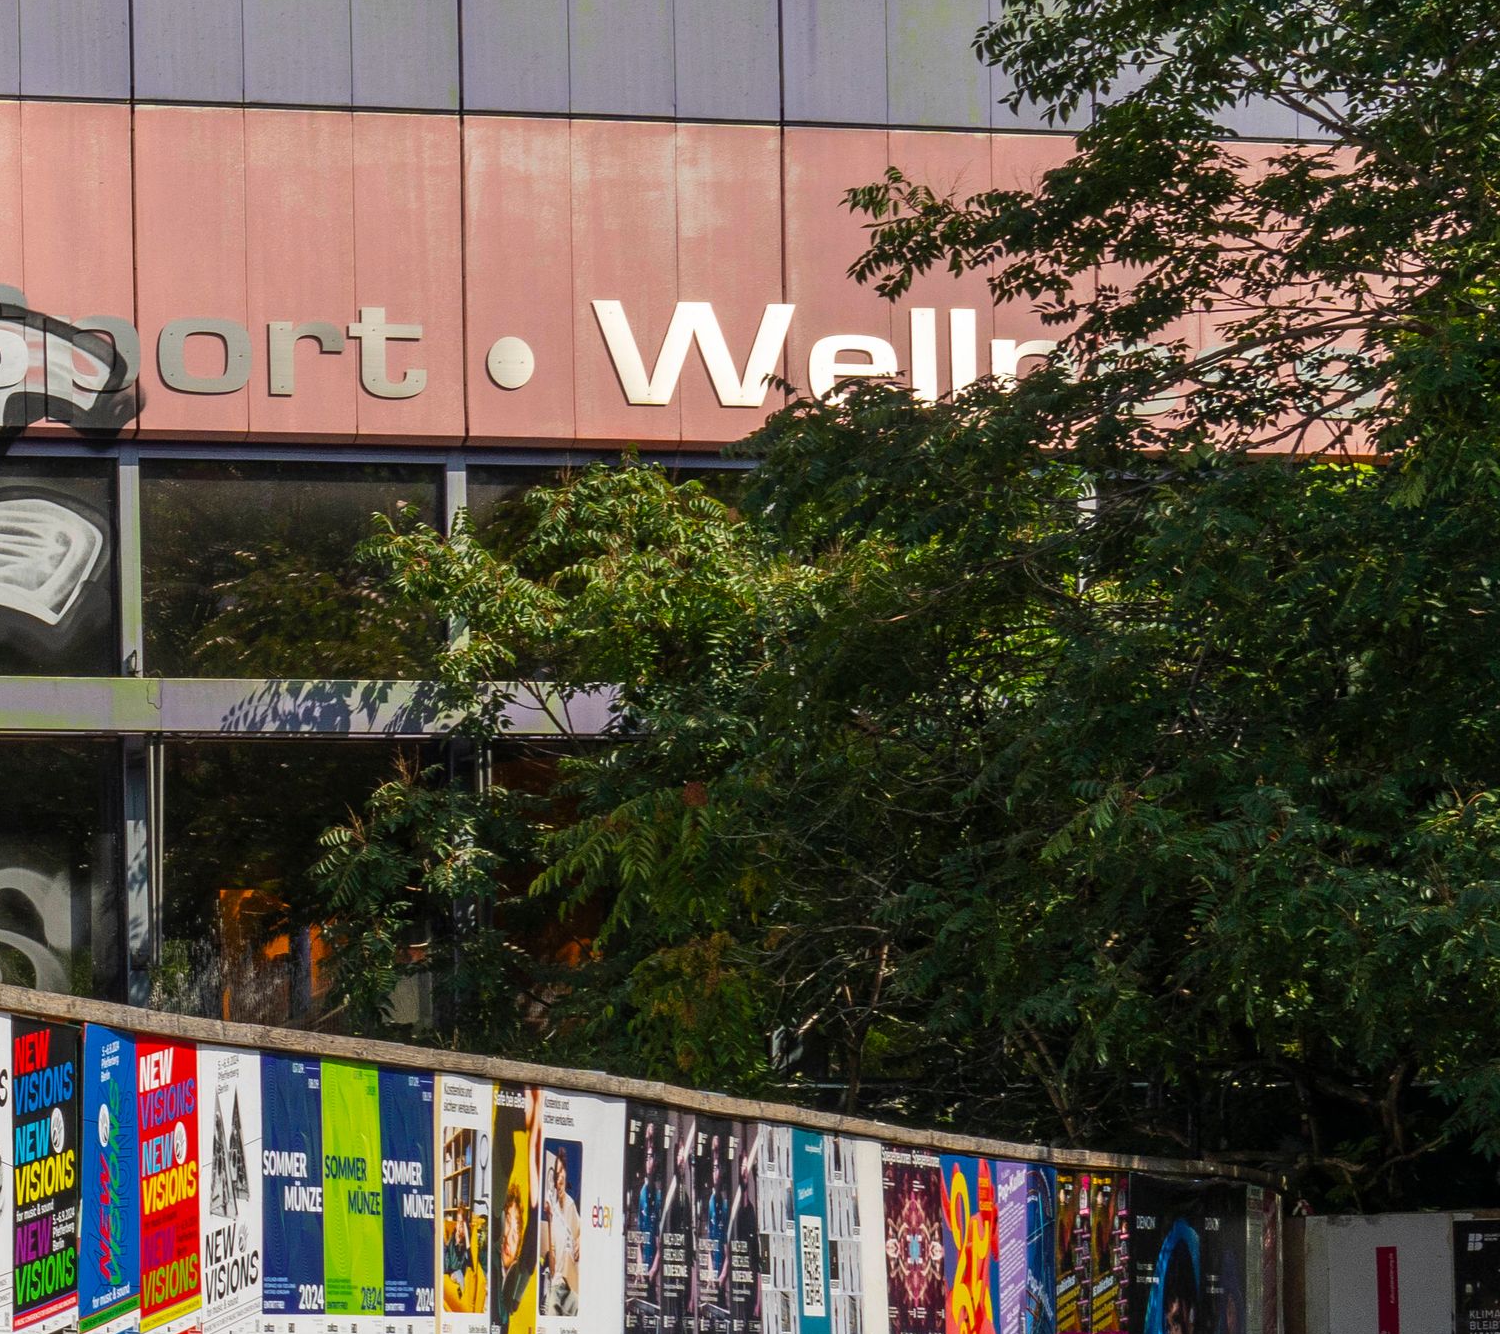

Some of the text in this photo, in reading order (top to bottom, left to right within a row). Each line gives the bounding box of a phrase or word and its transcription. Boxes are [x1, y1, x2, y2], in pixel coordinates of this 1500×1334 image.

[13, 1029, 51, 1076] NEW
[139, 1047, 174, 1093] NEW
[13, 1061, 73, 1116] VISIONS
[140, 1077, 196, 1132] VISIONS
[262, 1150, 308, 1179] SOMMER
[324, 1155, 368, 1182] SOMMER
[284, 1180, 322, 1213] MÜNZE
[348, 1186, 382, 1217] MÜNZE
[591, 1197, 613, 1236] ebay
[205, 1222, 236, 1269] NEW
[14, 1247, 75, 1306] VISIONS
[205, 1249, 259, 1305] VISIONS
[298, 1284, 325, 1310] 2024
